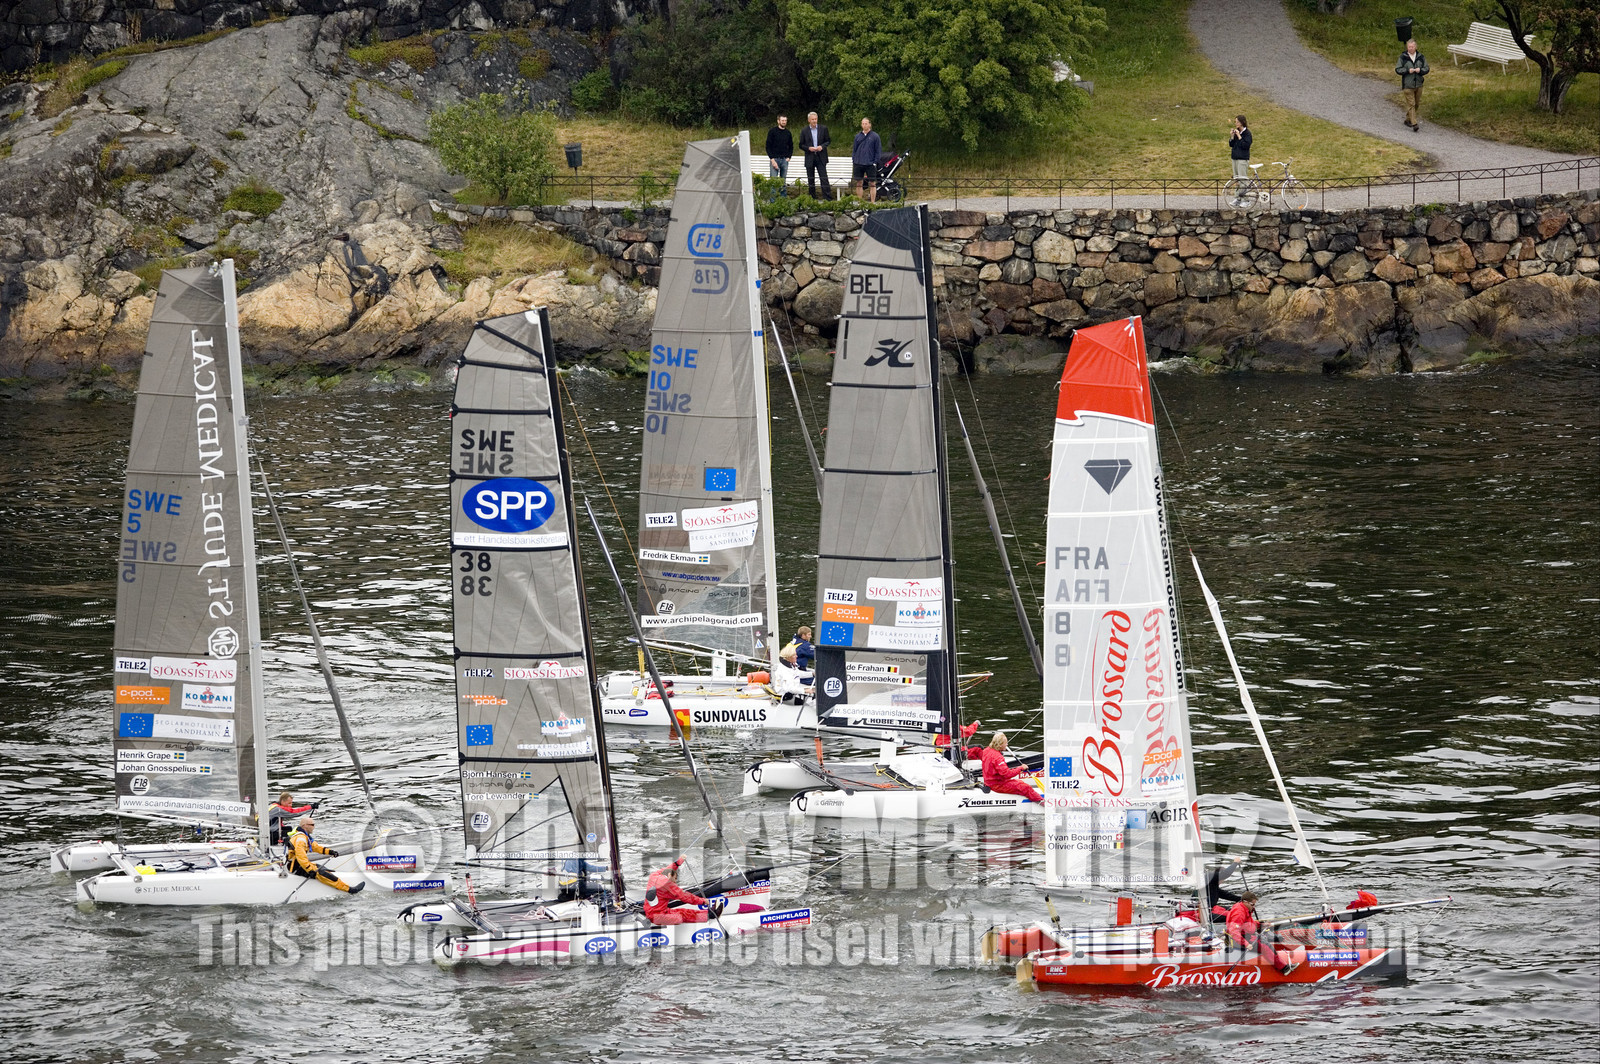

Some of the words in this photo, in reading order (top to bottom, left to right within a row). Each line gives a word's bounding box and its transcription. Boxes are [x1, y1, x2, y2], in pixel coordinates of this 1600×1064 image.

[696, 233, 722, 249] F18
[850, 274, 893, 294] BEL
[652, 345, 698, 369] SWE
[650, 371, 671, 391] 10
[460, 429, 515, 452] SWE
[127, 489, 183, 516] SWE
[475, 490, 547, 520] SPP
[127, 513, 142, 533] 5
[648, 515, 674, 525] TELE2
[685, 510, 756, 528] SJÖASSISTANS
[463, 535, 475, 543] ett
[460, 551, 491, 572] 38
[643, 551, 669, 560] Fredrik
[670, 554, 696, 563] Ekman
[1055, 547, 1109, 570] FRA
[1153, 475, 1185, 690] www.team-ocean.com
[827, 592, 854, 602] TELE2
[868, 586, 942, 598] SJÖASSISTANS
[659, 602, 674, 611] F18
[899, 609, 941, 617] KOMPANI
[646, 615, 759, 625] www.archipelagoraid.com
[1055, 611, 1071, 635] 8
[888, 638, 931, 646] SANDHAMN
[119, 660, 147, 671] TELE2
[857, 664, 884, 672] Frahan
[153, 665, 234, 680] SJÖASSISTANS
[464, 669, 493, 678] TELE2
[504, 666, 584, 679] SJÖASSISTANS
[827, 680, 841, 689] F18
[185, 692, 232, 702] KOMPANI
[1082, 610, 1131, 797] Brossard
[694, 709, 767, 723] SUNDVALLS
[155, 719, 222, 730] SEGLARHOTELLET
[541, 717, 586, 728] KOMPANI
[897, 719, 923, 727] TIGER
[174, 727, 220, 737] SANDHAMN
[119, 751, 145, 759] Henrik
[146, 752, 171, 761] Grape
[537, 749, 583, 757] SANDHAMN
[147, 765, 197, 773] Gnosspelius
[486, 770, 518, 778] Hansen
[133, 778, 148, 787] F18
[1141, 773, 1184, 784] KOMPANI
[1051, 780, 1080, 790] TELE2
[486, 792, 526, 800] Lewander
[123, 799, 247, 813] www.scandinavianislands.com
[1047, 797, 1132, 808] SJÖASSISTANS
[474, 814, 489, 824] F18
[1148, 807, 1188, 823] AGIR
[1048, 833, 1069, 841] Yvan
[1071, 834, 1112, 842] Bourgnon
[1048, 842, 1075, 850] Olivier
[1077, 843, 1111, 851] Gagliani
[368, 856, 415, 864] ARCHIPELAGO
[1057, 874, 1184, 883] www.scandinavianislands.com
[762, 911, 808, 922] ARCHIPELAGO
[695, 929, 723, 942] SPP
[588, 939, 615, 951] SPP
[642, 936, 667, 947] SPP
[1145, 963, 1261, 988] Brossard
